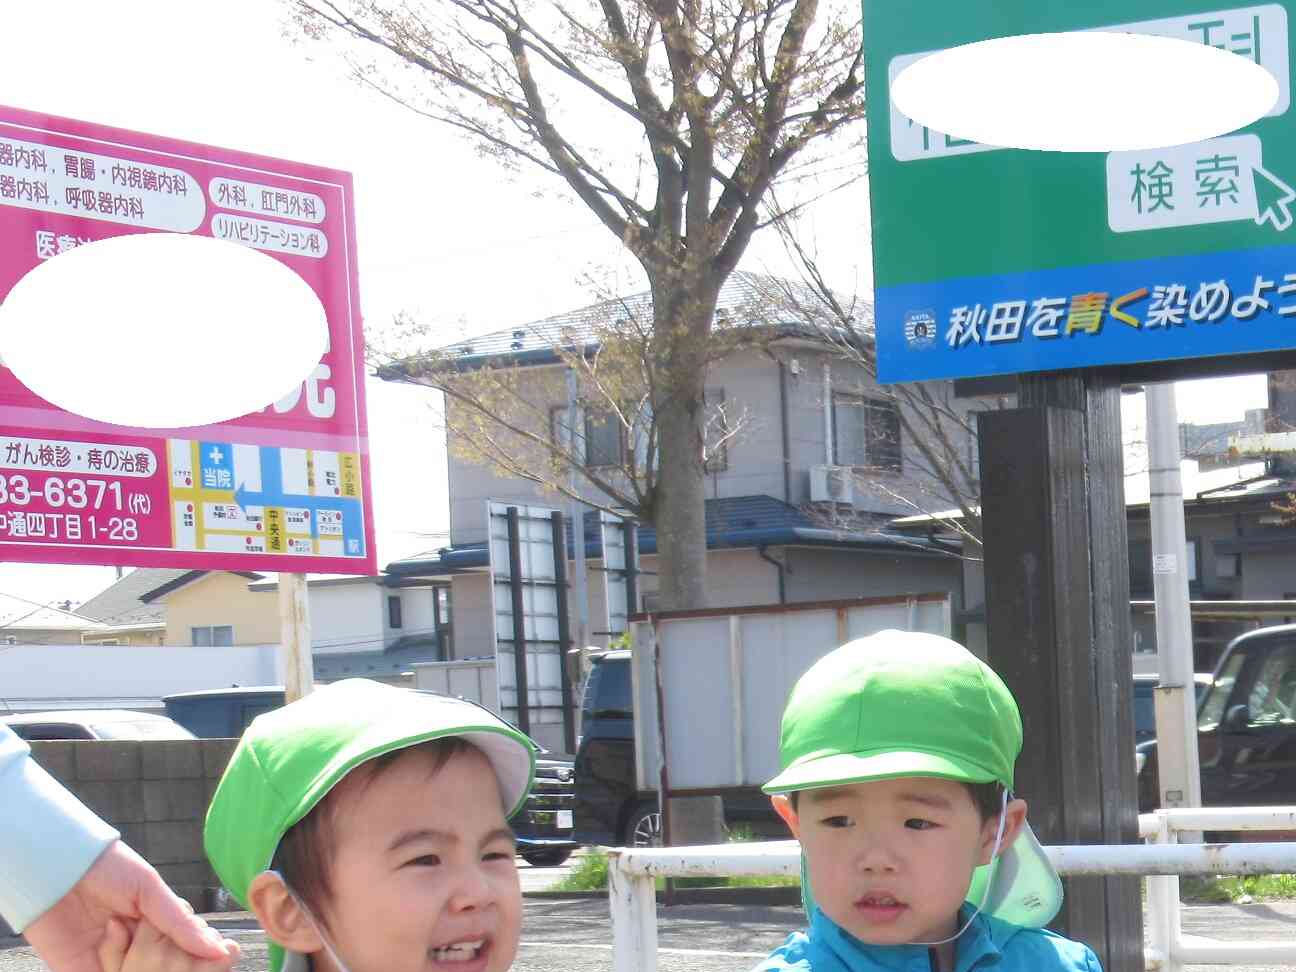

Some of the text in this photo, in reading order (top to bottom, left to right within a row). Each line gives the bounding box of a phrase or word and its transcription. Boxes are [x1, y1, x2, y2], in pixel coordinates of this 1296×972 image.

[1129, 154, 1240, 214] 検索
[219, 218, 320, 253] リハビリテーション科
[6, 442, 150, 474] がん検診・痔の治療
